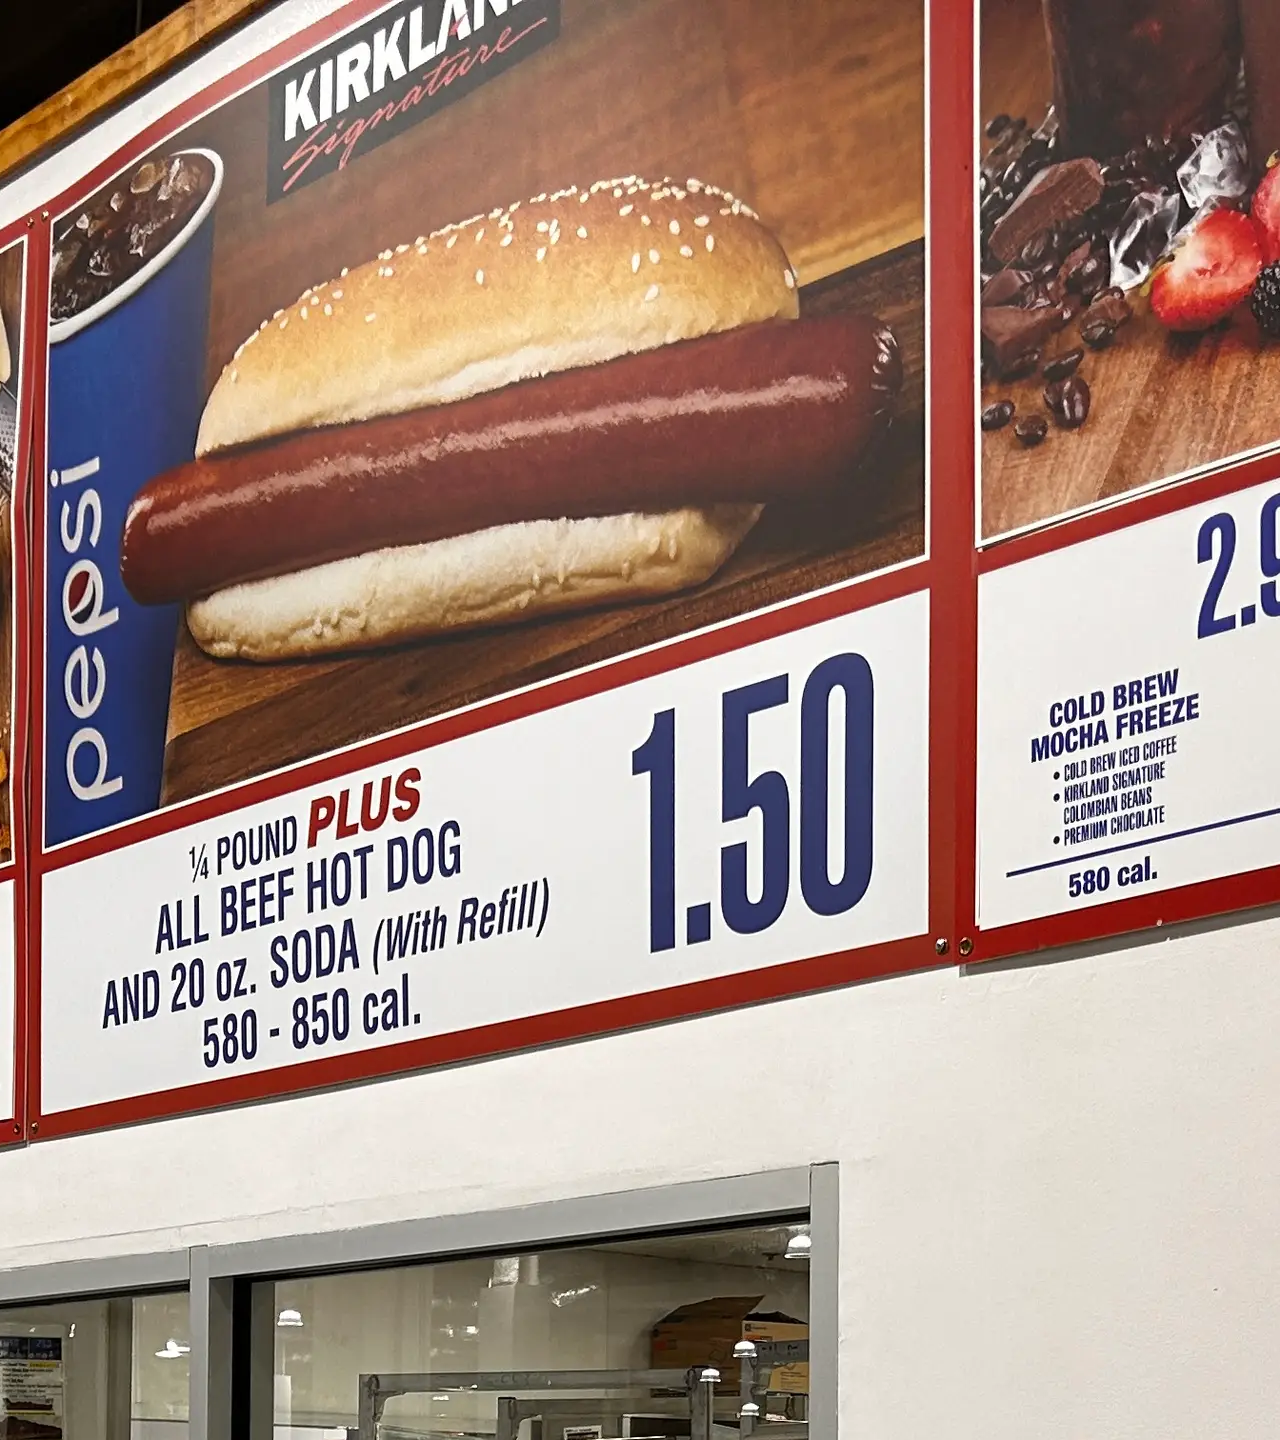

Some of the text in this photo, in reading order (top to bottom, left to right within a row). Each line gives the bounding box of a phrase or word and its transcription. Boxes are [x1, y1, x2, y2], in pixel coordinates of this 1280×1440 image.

[282, 18, 548, 193] Signature
[51, 456, 123, 803] pepsi
[1031, 693, 1199, 762] MOCHA FREEZE
[1049, 668, 1179, 728] COLD BREW
[1064, 735, 1178, 782] COLD BREW ICED COFFEE
[1064, 761, 1166, 805] KIRKLAND SIGNATURE
[217, 814, 297, 877] POUND
[306, 767, 421, 850] PLUS
[631, 650, 875, 954] 1.50
[1064, 787, 1152, 824] COLOMBIAN BEANS
[1064, 805, 1165, 846] PREMIUM CHOCOLATE
[156, 819, 461, 954] ALL BEEF HOT DOG
[1068, 856, 1158, 899] 580 cal.
[103, 877, 551, 1030] AND 20 oz. SODA (With Refill)
[202, 1010, 257, 1069] 580
[291, 992, 350, 1048] 850
[362, 974, 421, 1037] cal.
